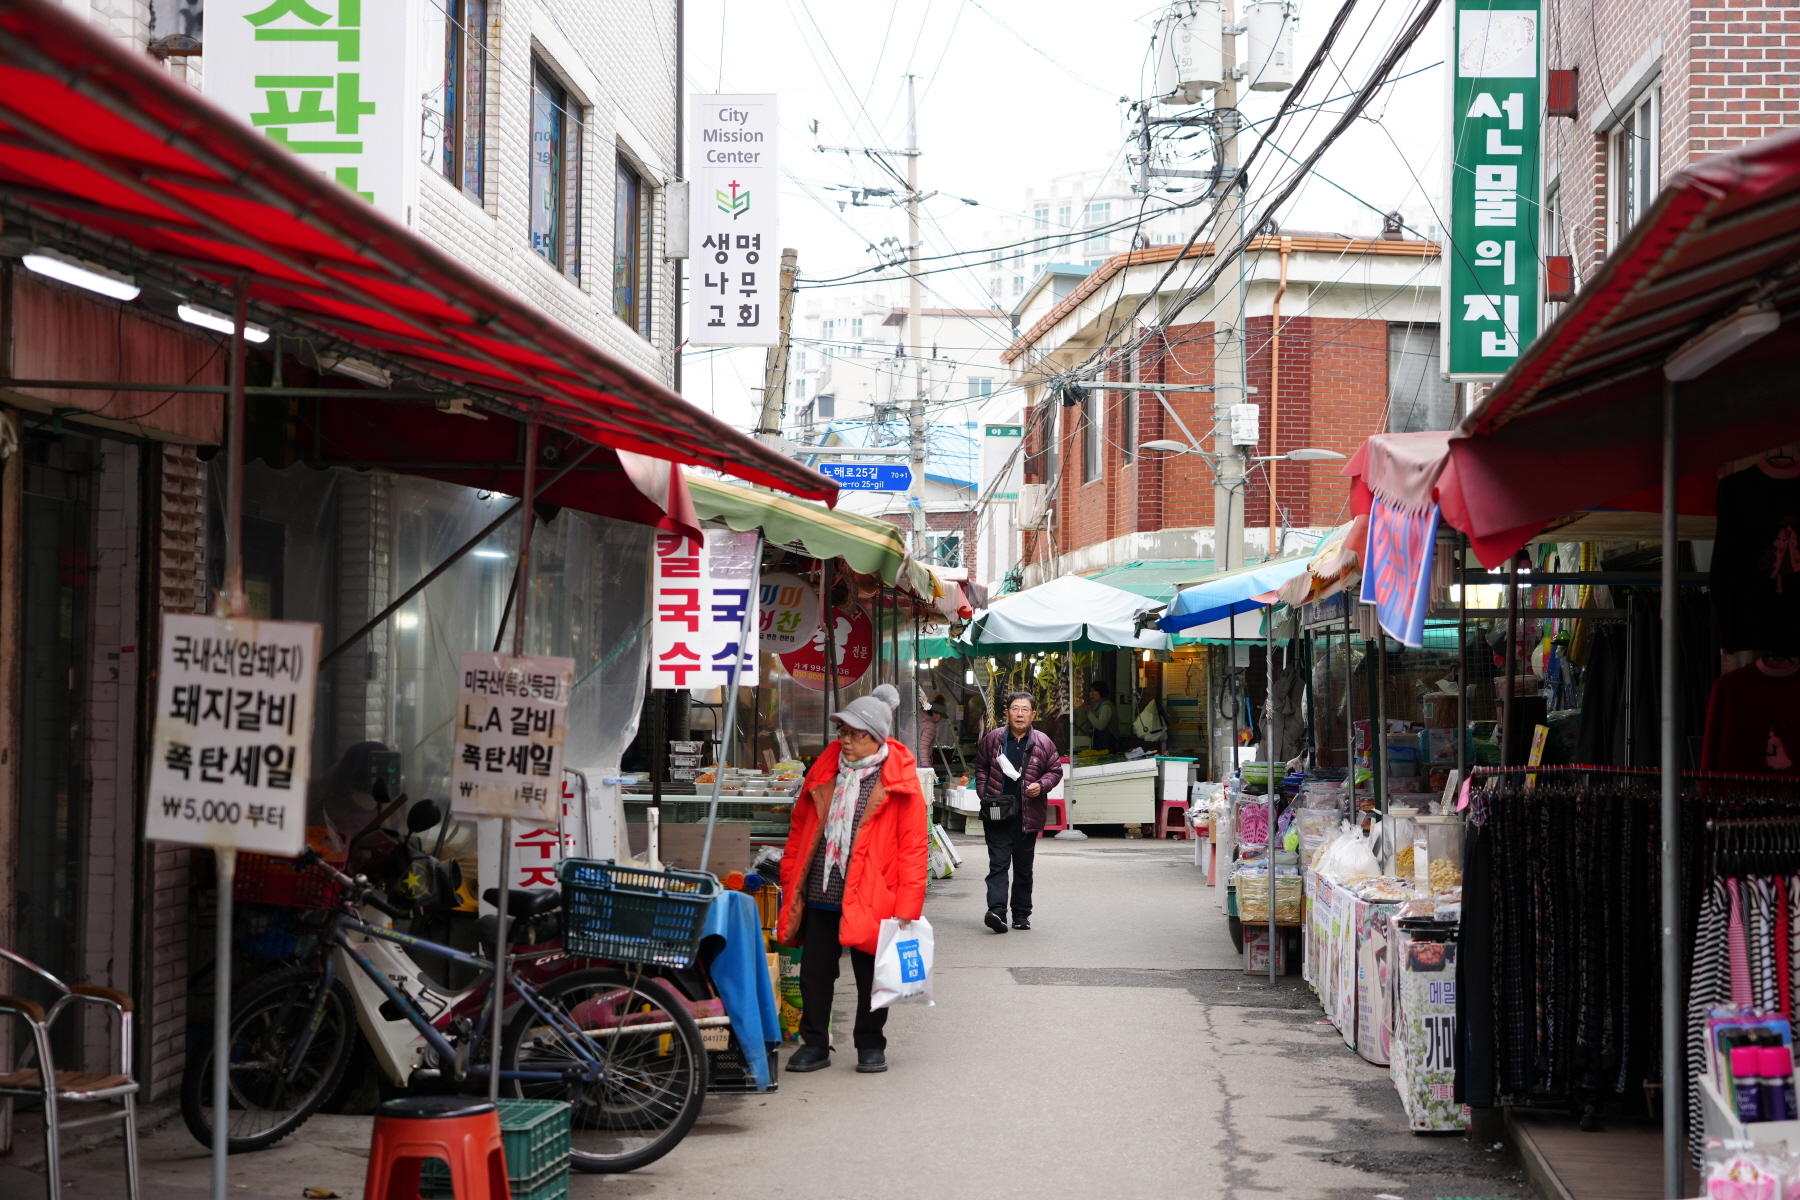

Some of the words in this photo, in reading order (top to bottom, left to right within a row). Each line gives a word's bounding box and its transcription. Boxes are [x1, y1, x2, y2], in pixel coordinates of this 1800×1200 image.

[718, 107, 749, 125] City
[703, 128, 764, 143] Mission
[706, 149, 760, 163] Center
[707, 303, 760, 328] 교회
[824, 466, 879, 480] 노해로25길
[861, 480, 884, 490] 25-gil
[172, 635, 304, 683] 국내산(암돼지)
[169, 683, 297, 736] 돼지갈비
[510, 706, 556, 739] 갈비
[164, 741, 297, 791] 폭탄세일
[462, 743, 554, 777] 폭탄세일
[245, 803, 286, 831] 부터
